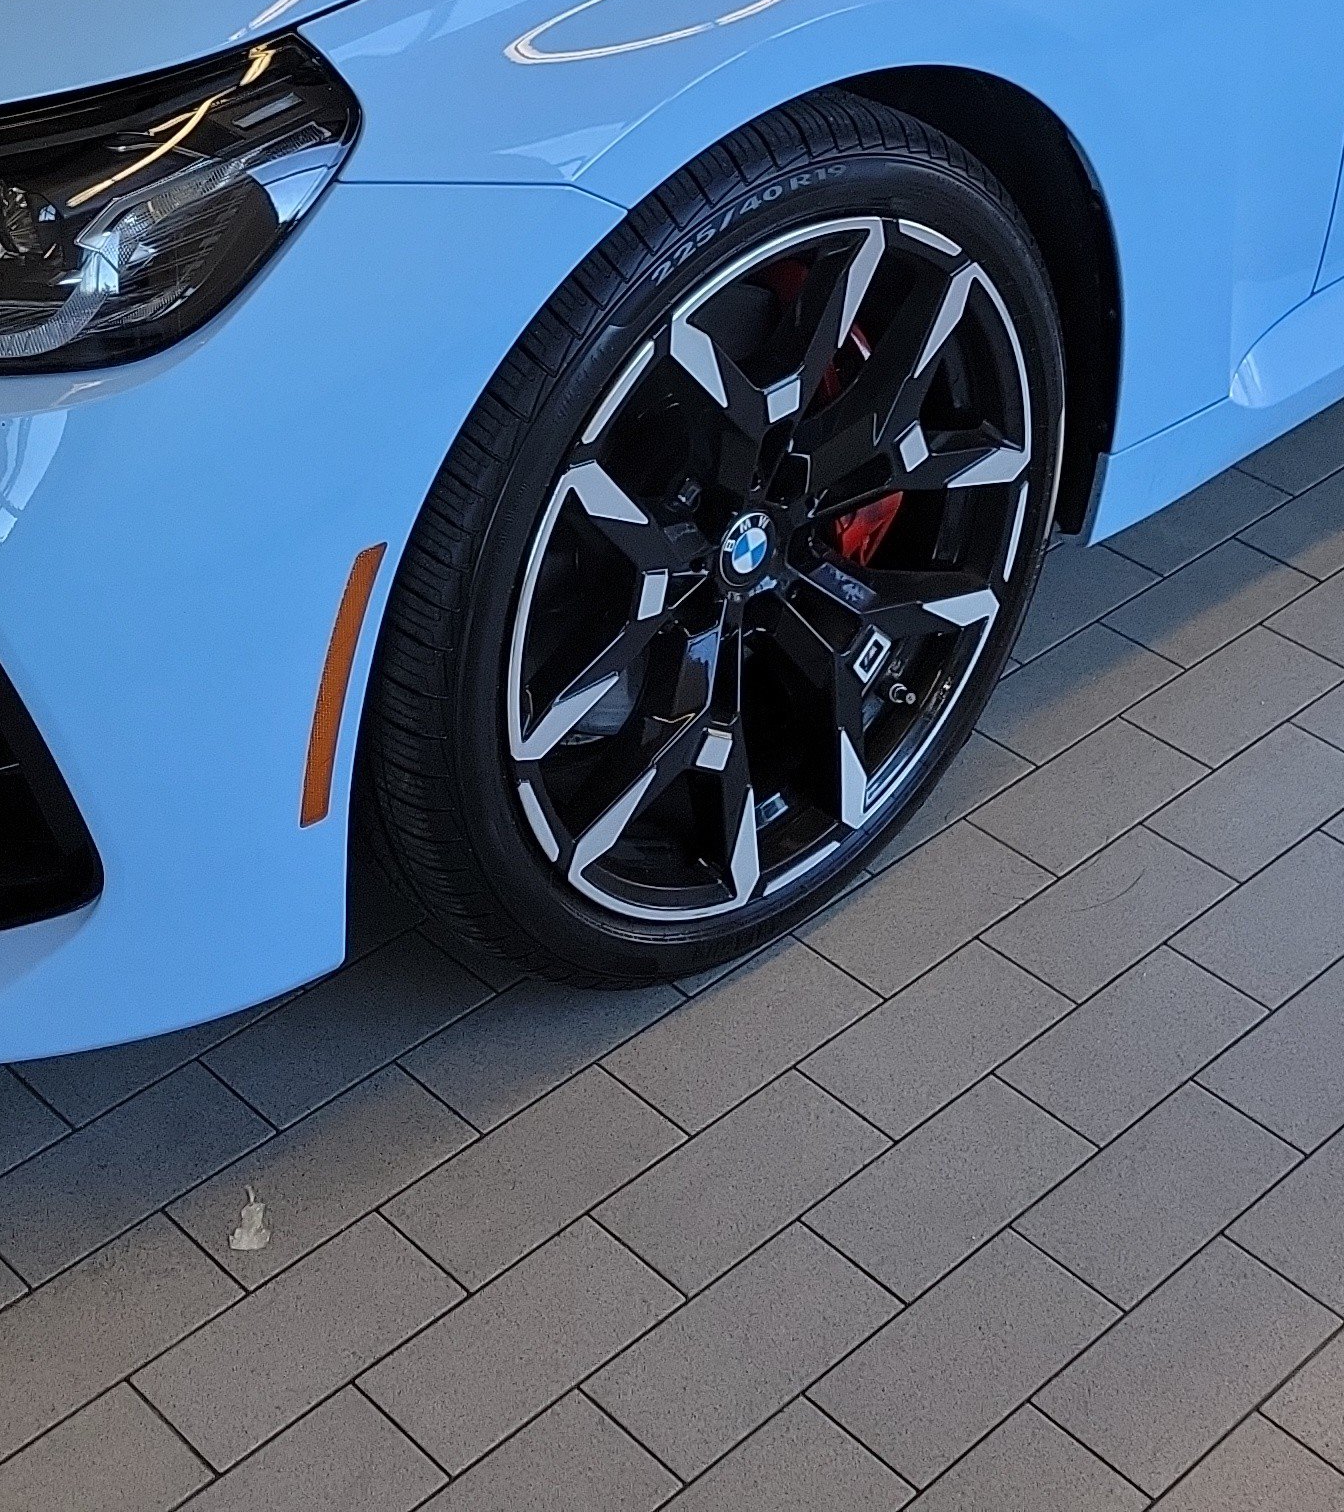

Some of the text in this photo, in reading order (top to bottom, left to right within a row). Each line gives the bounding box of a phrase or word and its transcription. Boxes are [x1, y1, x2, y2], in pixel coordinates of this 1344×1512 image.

[651, 163, 847, 287] 225/40 R19
[723, 515, 771, 553] BMW
